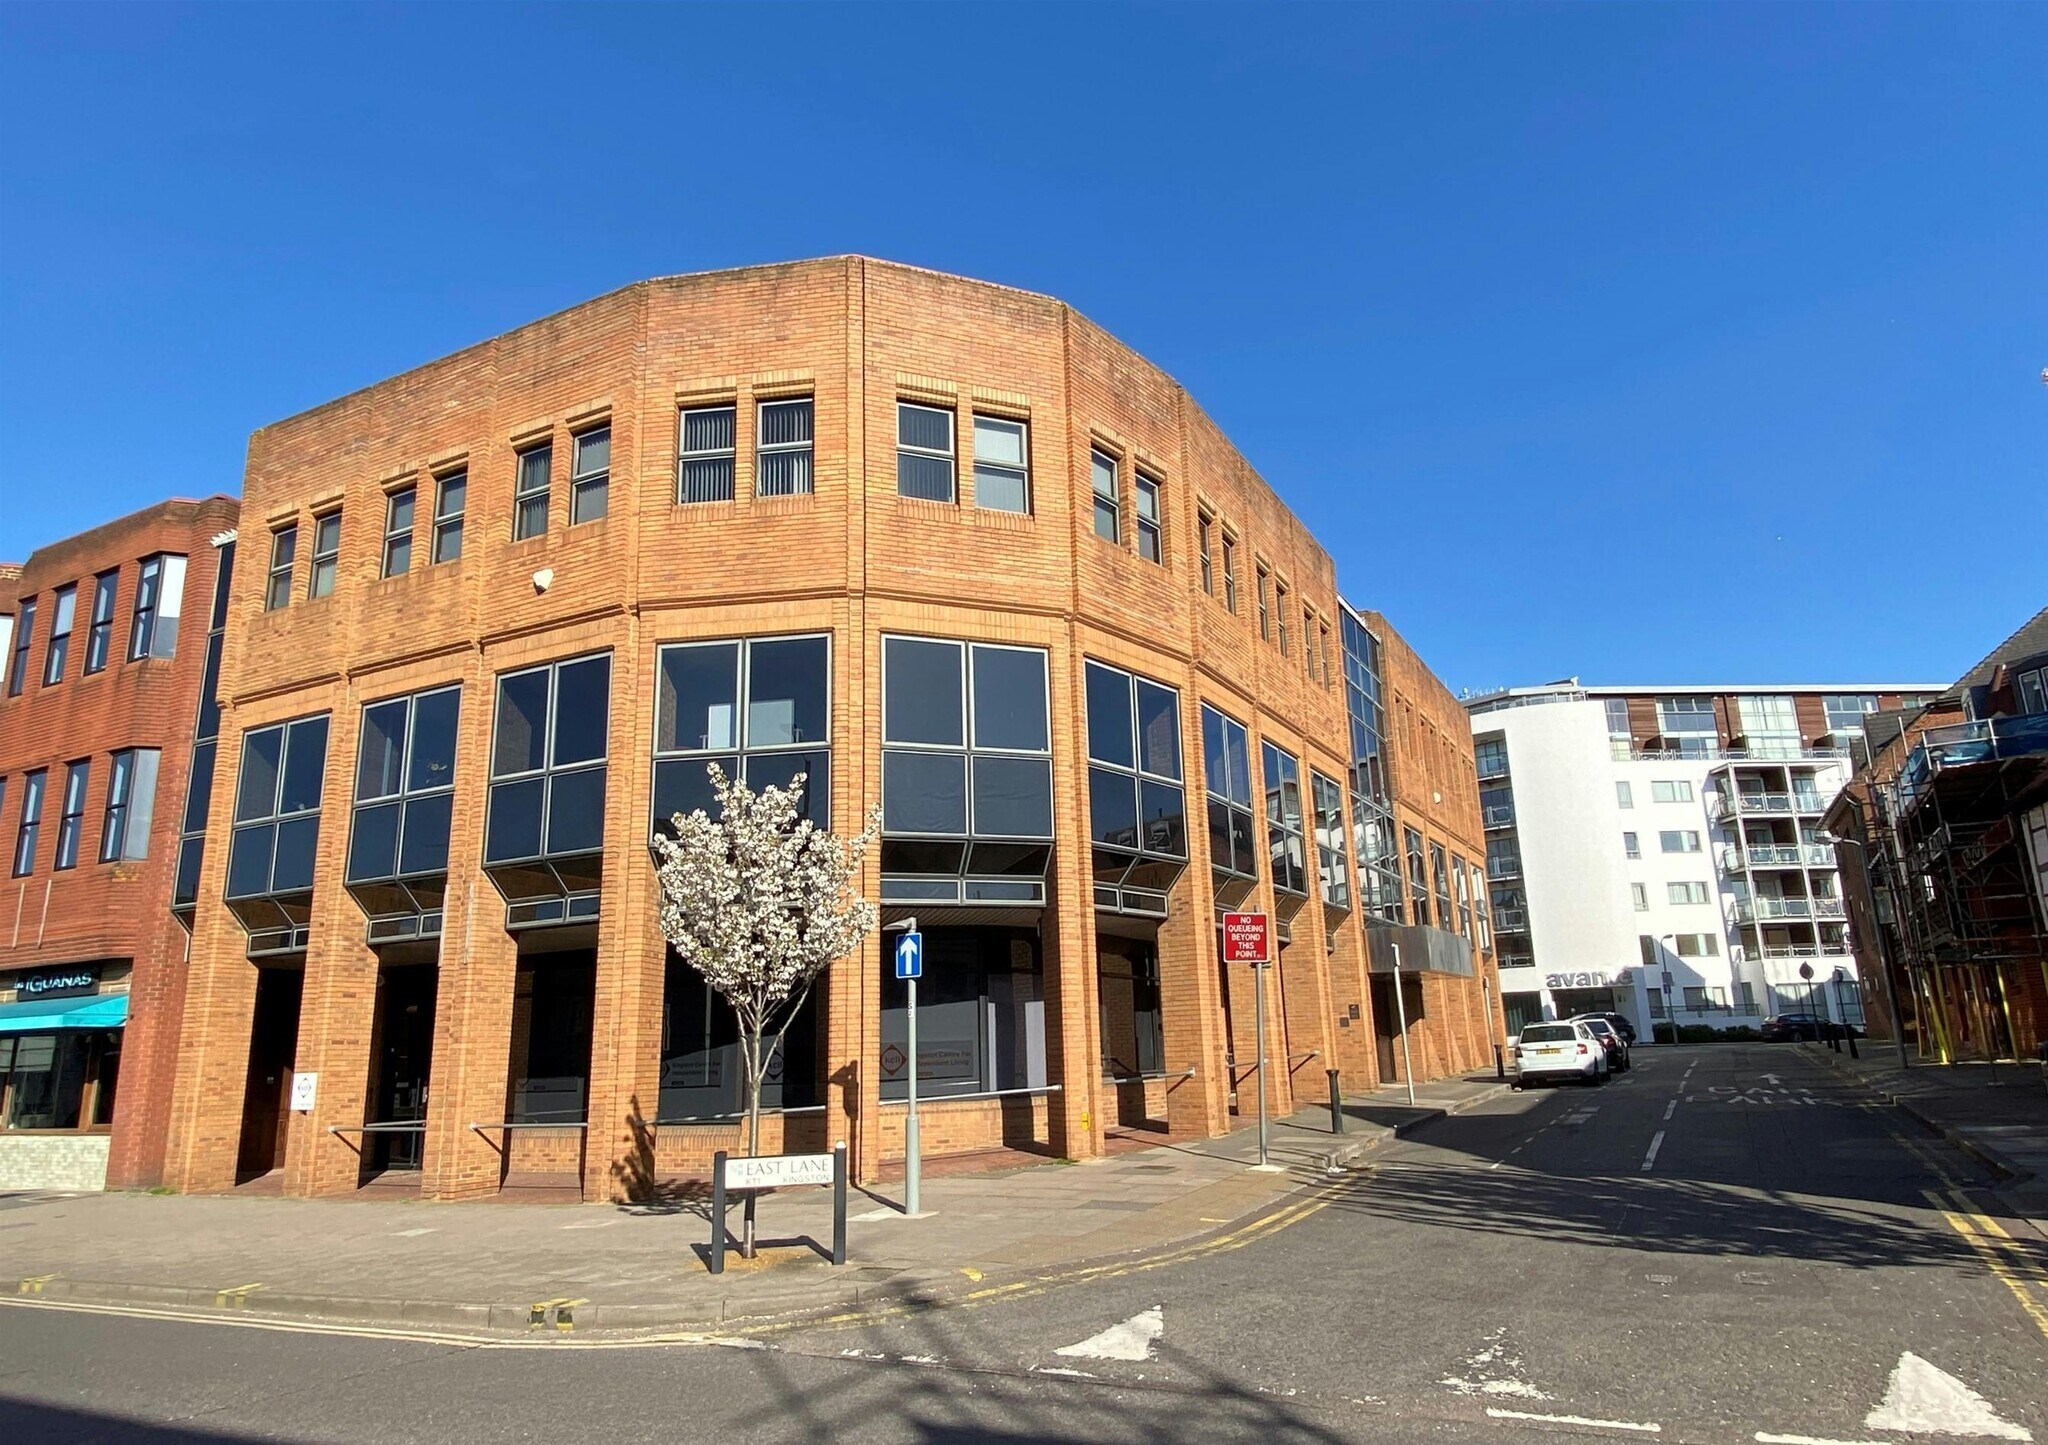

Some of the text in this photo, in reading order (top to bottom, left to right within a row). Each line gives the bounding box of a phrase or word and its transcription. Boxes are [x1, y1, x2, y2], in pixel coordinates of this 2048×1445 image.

[1231, 933, 1261, 941] BEYOND
[1238, 941, 1255, 949] THIS
[1235, 950, 1257, 958] POINT
[746, 1158, 828, 1176] EAST LANE
[783, 1174, 830, 1183] KINGSTON
